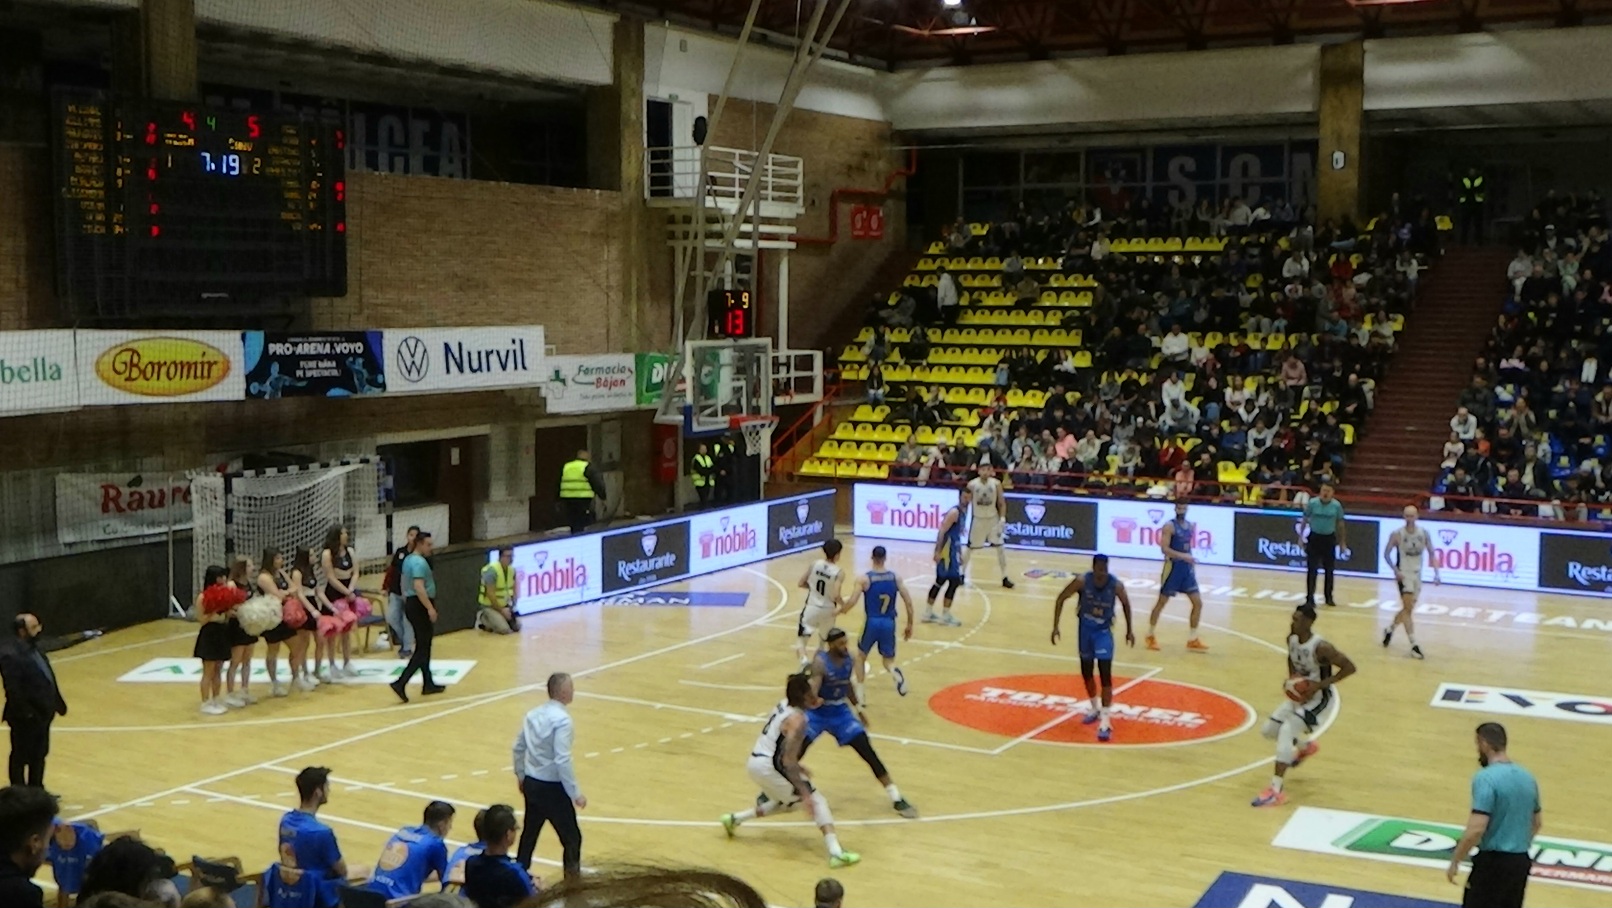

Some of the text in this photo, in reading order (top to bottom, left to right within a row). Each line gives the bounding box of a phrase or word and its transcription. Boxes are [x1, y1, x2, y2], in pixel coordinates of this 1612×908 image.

[206, 116, 216, 131] 4
[247, 115, 260, 138] 5
[252, 157, 261, 174] 2
[727, 309, 745, 335] 13
[112, 348, 218, 382] Boromir
[443, 338, 528, 375] Nurvil
[577, 362, 627, 376] Farmacia
[0, 356, 62, 384] bella
[890, 503, 944, 529] nobil
[705, 521, 757, 557] nobila
[1004, 521, 1075, 540] estaurante
[1140, 522, 1212, 549] nola
[618, 551, 676, 582] Restaurante
[1428, 542, 1514, 573] nobila
[528, 557, 588, 598] nobila
[880, 594, 891, 615] 7
